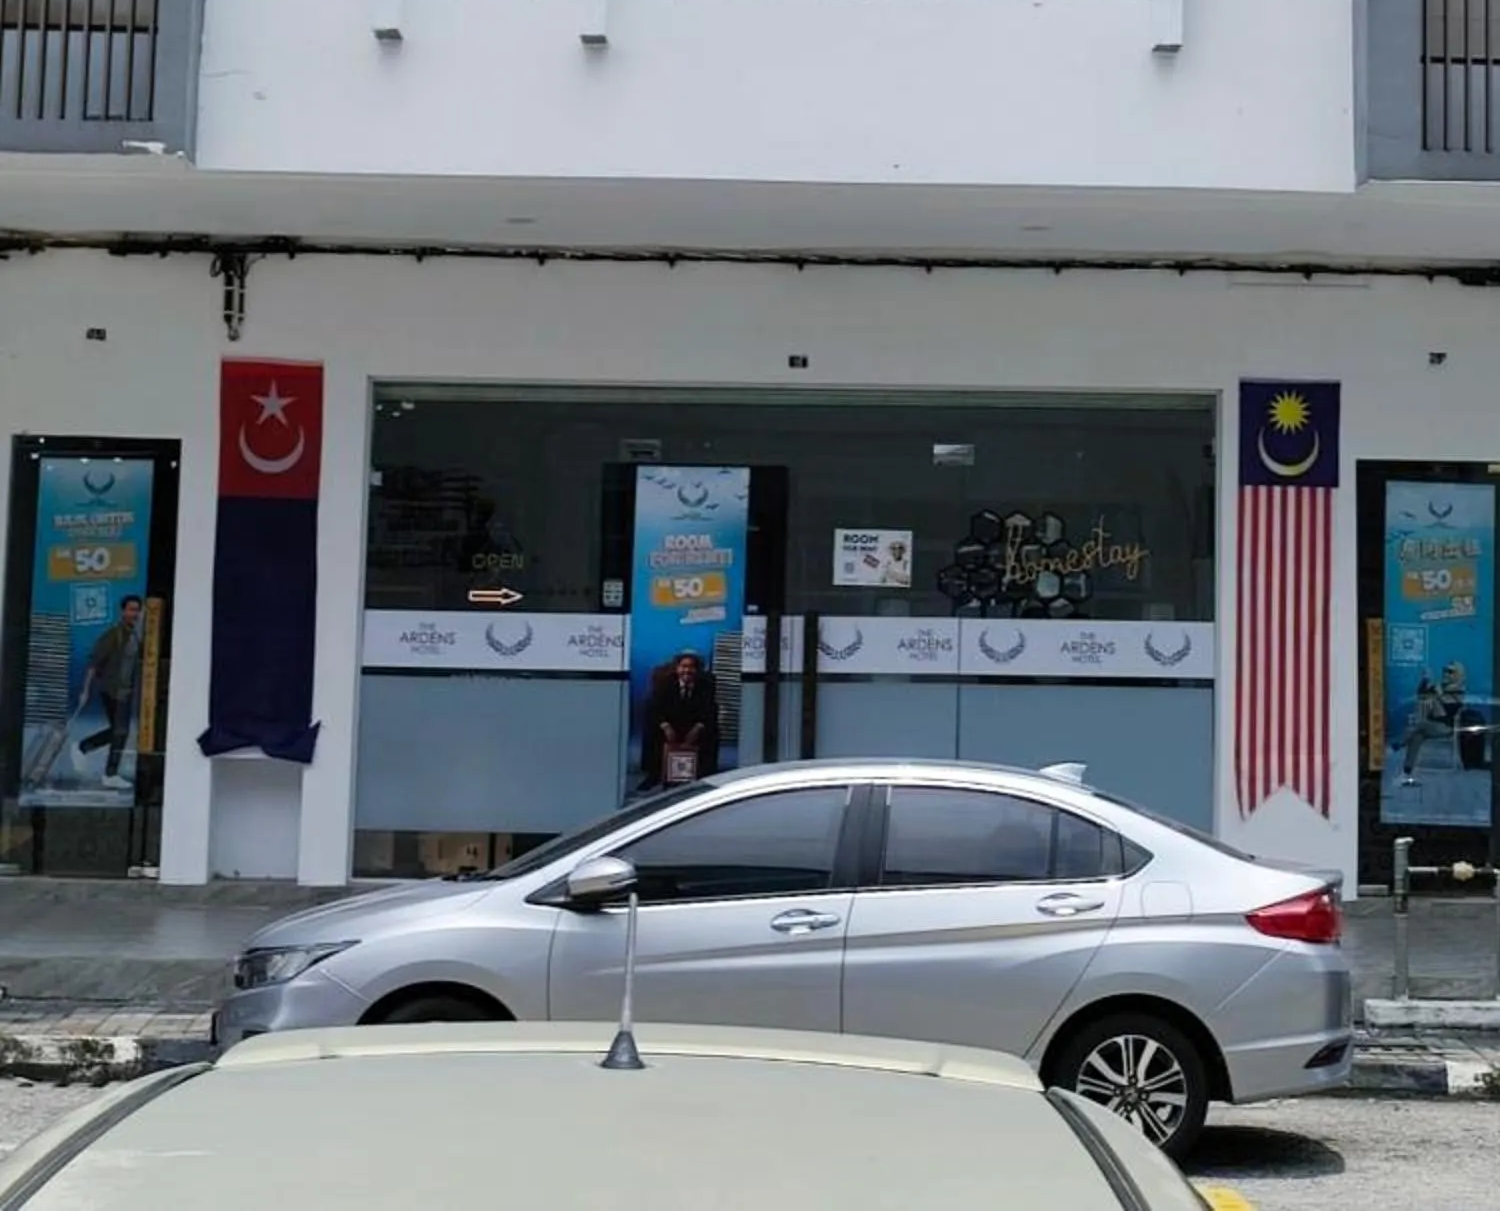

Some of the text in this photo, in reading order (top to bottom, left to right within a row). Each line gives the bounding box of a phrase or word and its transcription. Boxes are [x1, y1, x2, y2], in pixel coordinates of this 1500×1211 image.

[664, 535, 713, 549] ROOM
[75, 547, 110, 572] 50
[472, 553, 523, 569] OPEN
[1422, 569, 1452, 589] 50
[674, 577, 703, 598] 50
[400, 631, 456, 645] ARDENS
[567, 635, 624, 648] ARDENS
[897, 638, 953, 651] ARDENS
[1060, 641, 1116, 655] ARDENS
